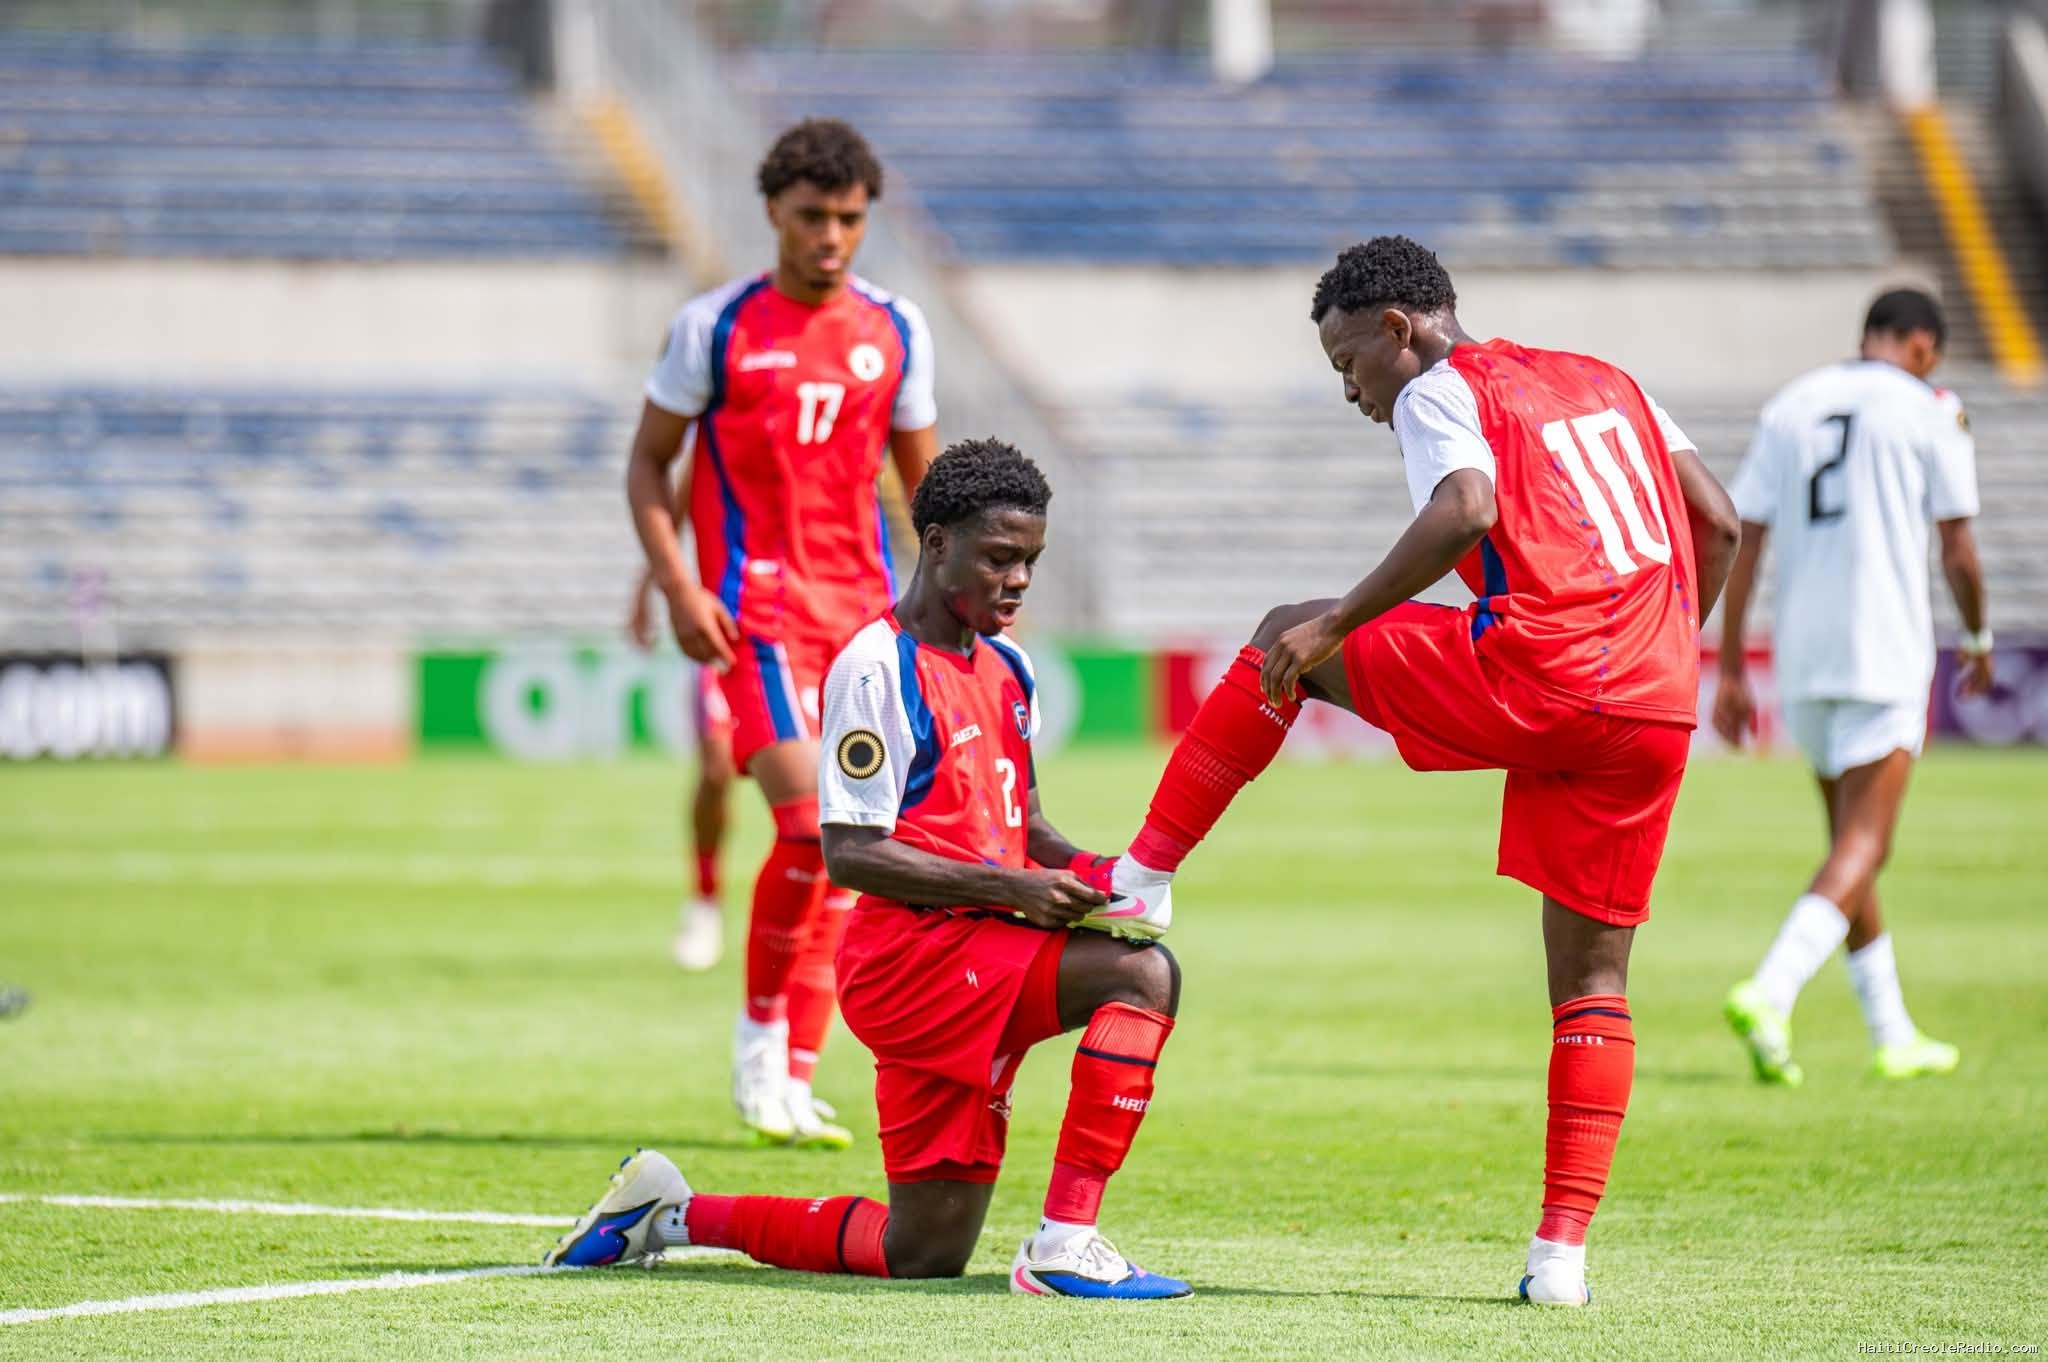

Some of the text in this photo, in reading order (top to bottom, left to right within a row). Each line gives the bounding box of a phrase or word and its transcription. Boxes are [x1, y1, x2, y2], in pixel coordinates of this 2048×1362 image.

[797, 381, 846, 445] 17
[1541, 407, 1673, 576] 10
[1809, 413, 1855, 527] 2
[994, 757, 1023, 828] 2
